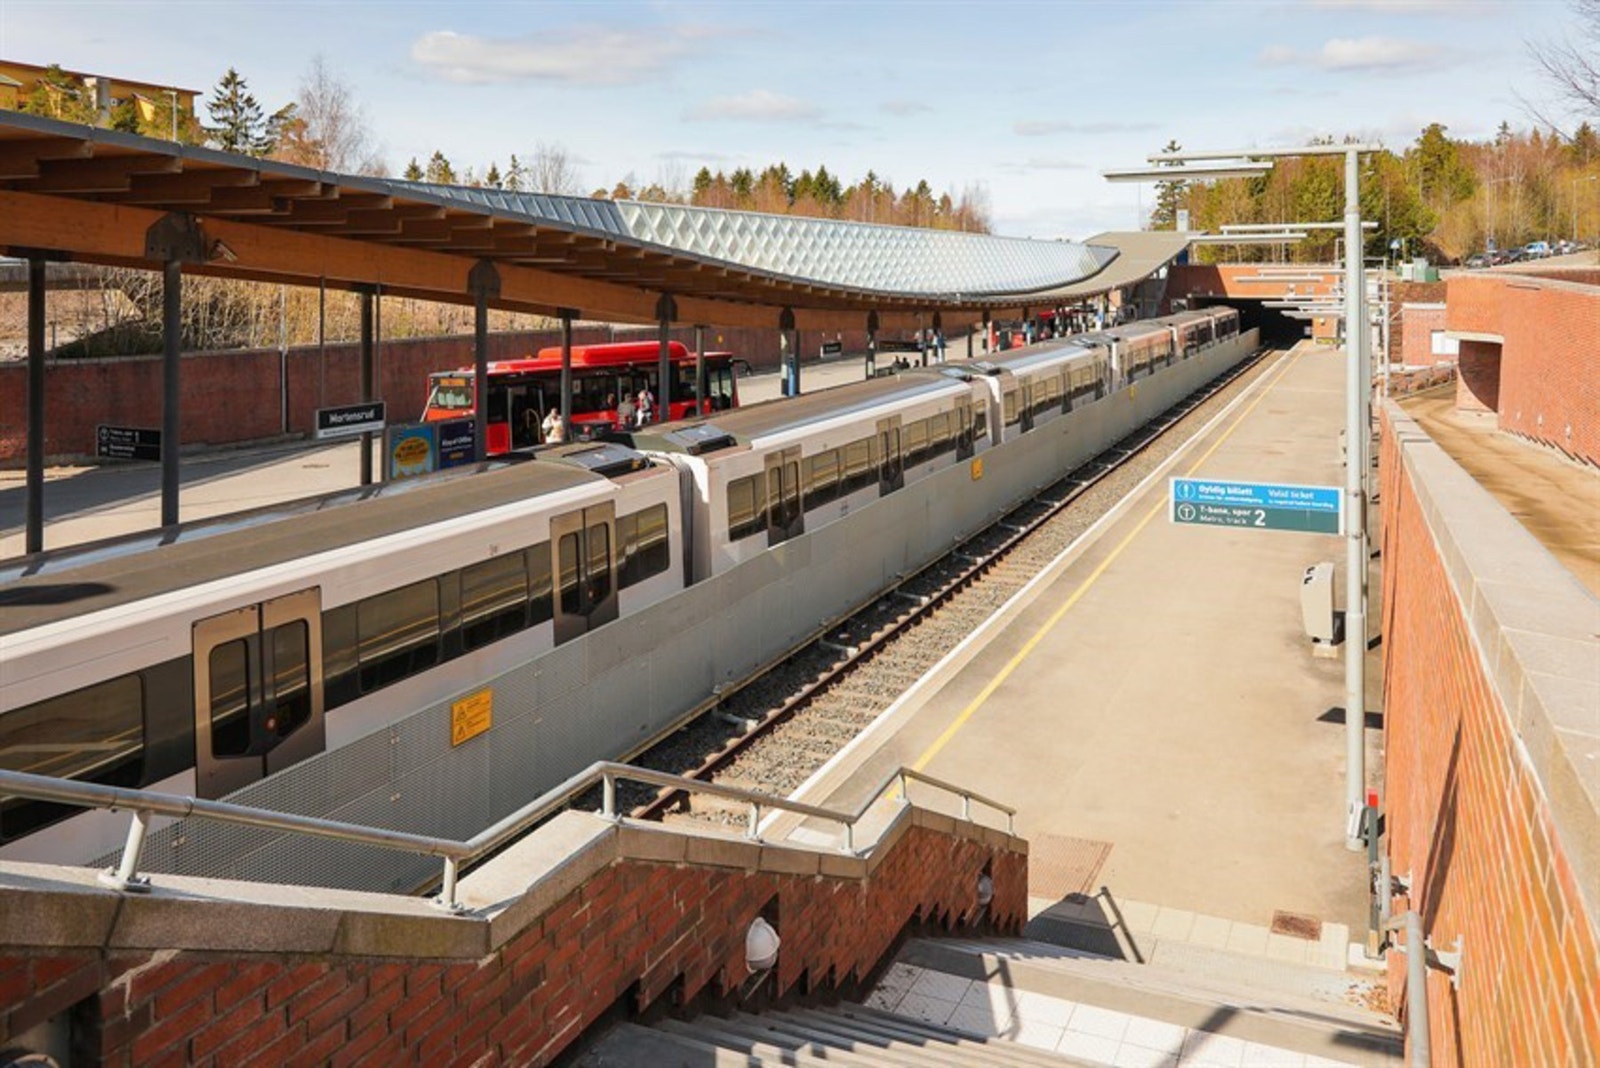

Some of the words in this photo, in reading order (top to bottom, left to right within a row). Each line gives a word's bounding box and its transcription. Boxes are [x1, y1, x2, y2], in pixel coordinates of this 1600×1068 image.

[329, 409, 375, 424] Mortensrud
[1198, 484, 1225, 496] Gyldig
[1227, 486, 1252, 496] billett
[1268, 489, 1289, 498] Valid
[1290, 490, 1315, 500] ticket
[1227, 517, 1248, 525] track
[1232, 510, 1252, 518] spor
[1254, 509, 1266, 527] 2
